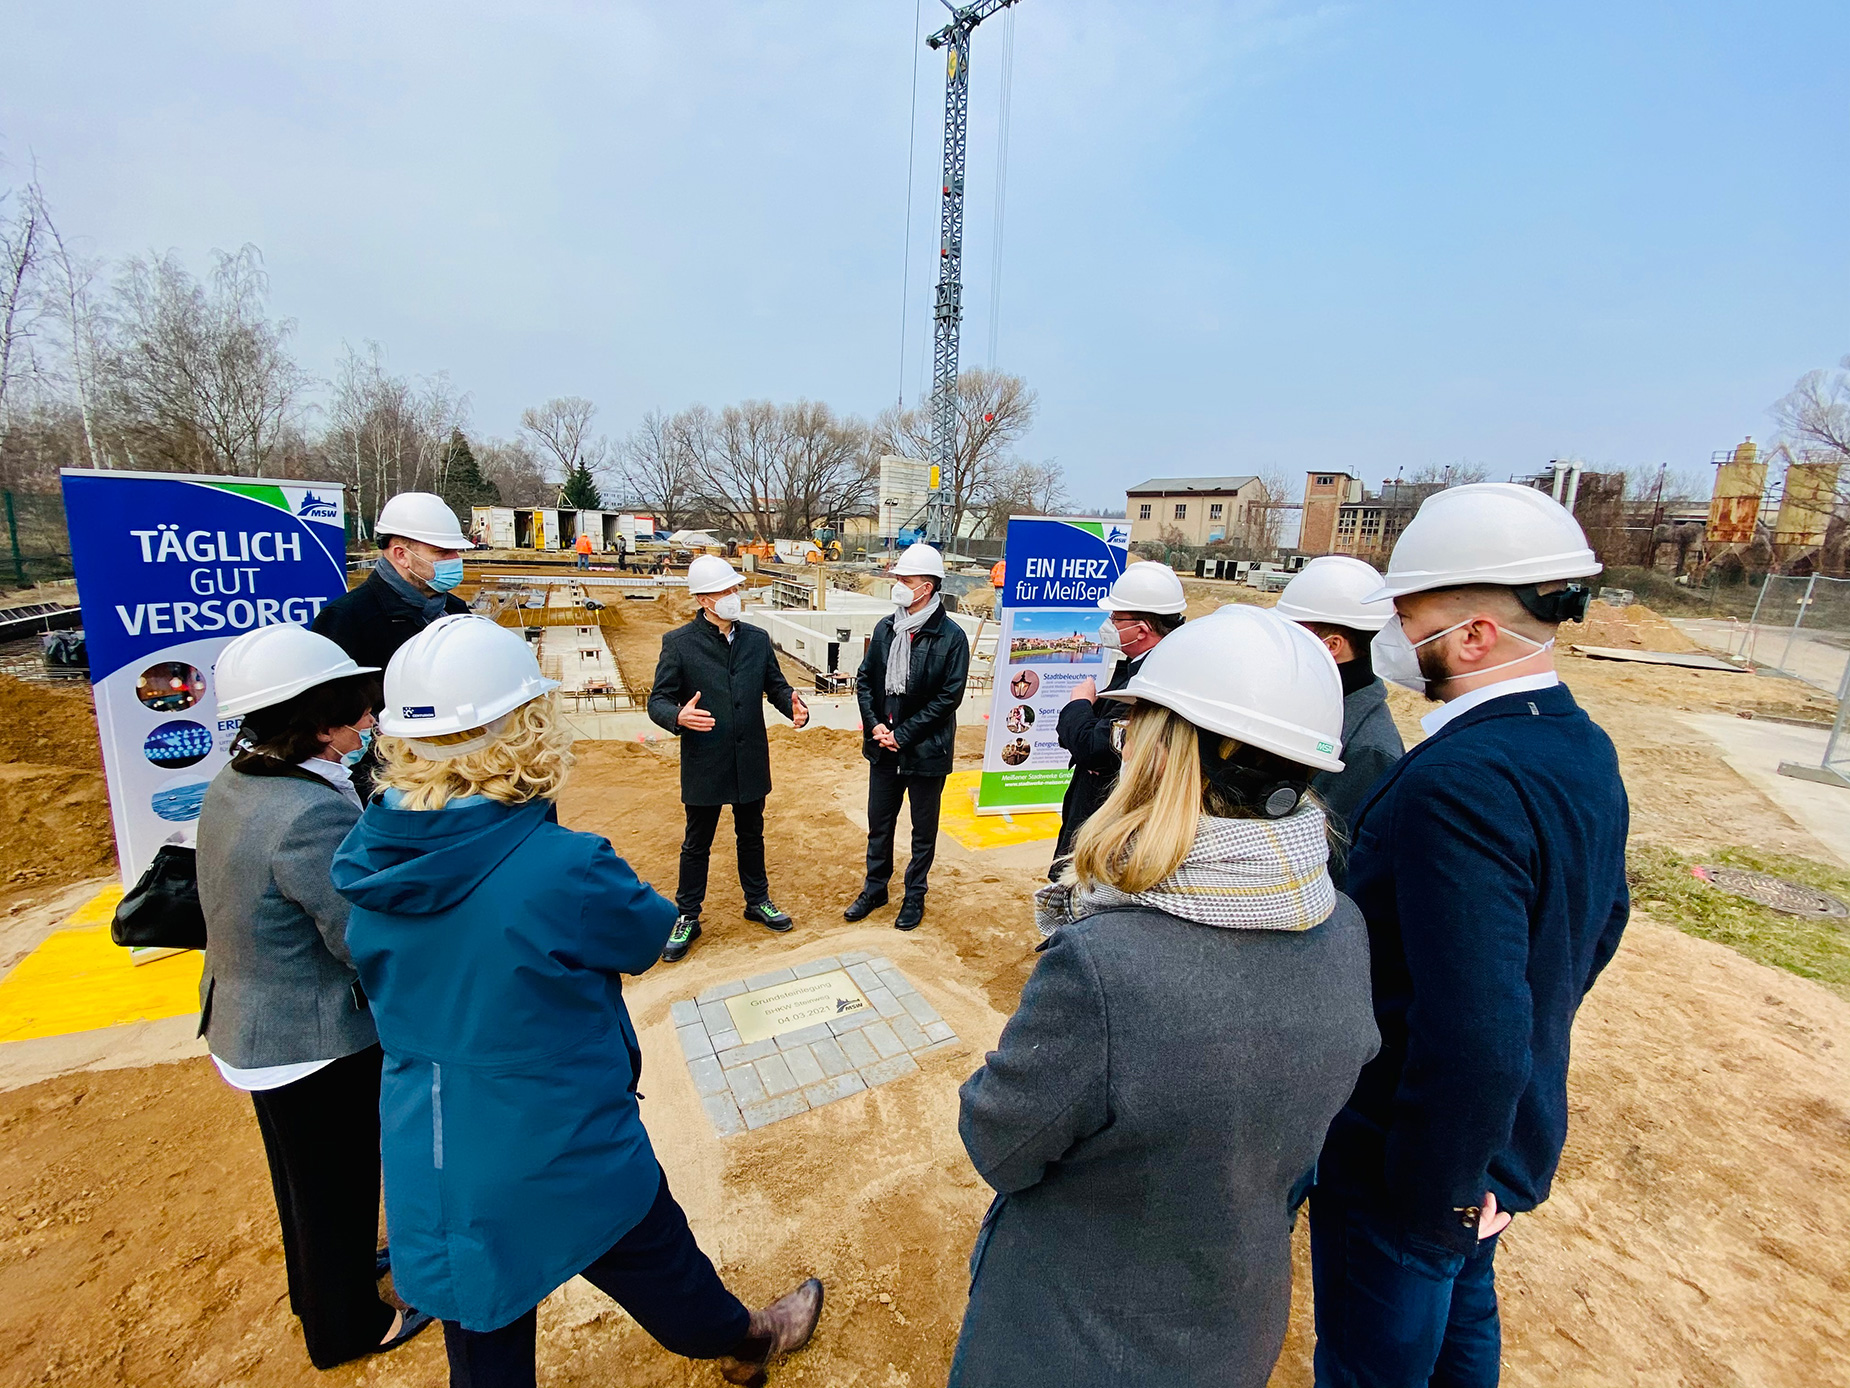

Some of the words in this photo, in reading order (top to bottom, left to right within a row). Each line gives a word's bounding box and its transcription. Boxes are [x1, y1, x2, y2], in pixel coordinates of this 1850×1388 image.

[130, 523, 301, 562] TÄGLICH
[1026, 558, 1055, 578] EIN
[1061, 559, 1109, 578] HERZ
[190, 568, 260, 595] GUT
[1016, 581, 1038, 600] für
[115, 597, 327, 636] VERSORGT
[750, 982, 832, 1007] Grundsteinlegung
[764, 1004, 792, 1016] BHKW
[793, 994, 830, 1008] Steinweg
[777, 1005, 831, 1025] 04.03.2021
[845, 1003, 863, 1011] MSW
